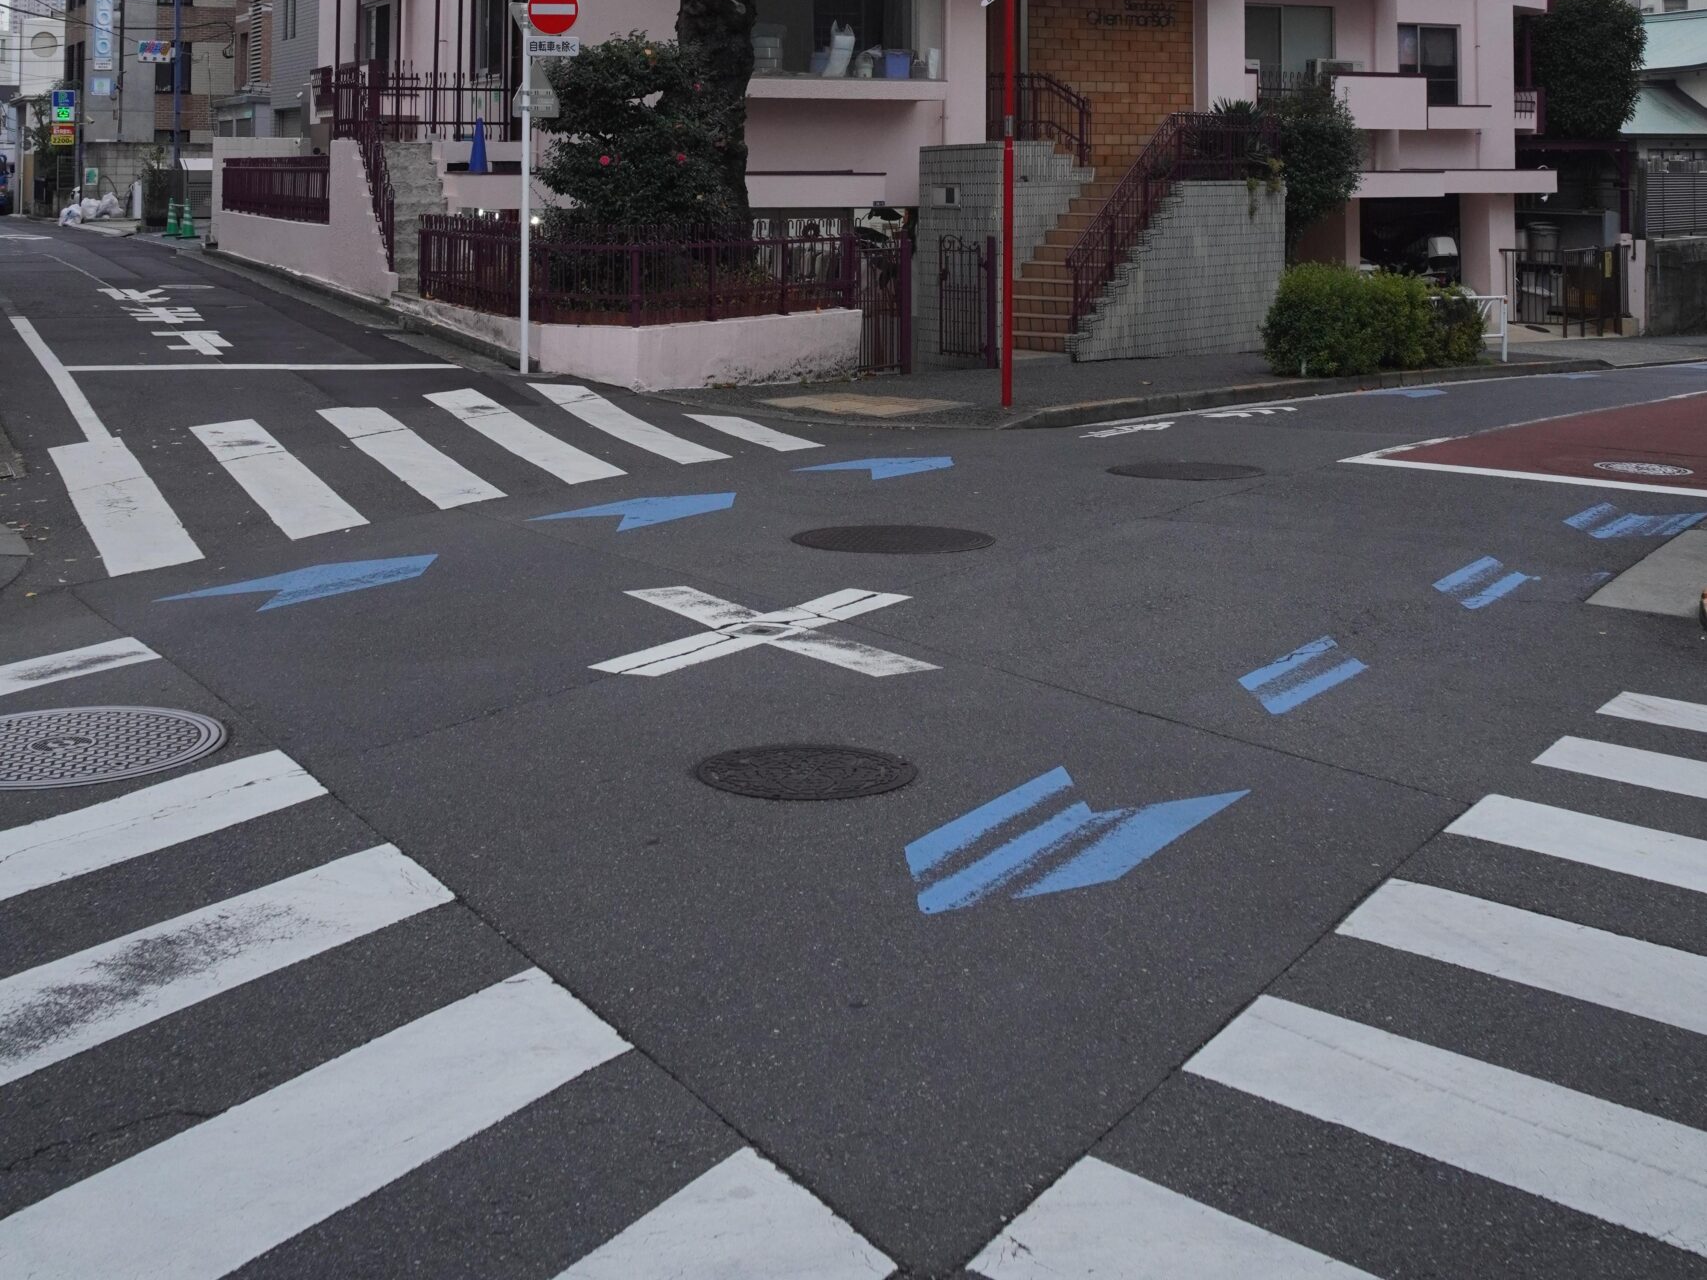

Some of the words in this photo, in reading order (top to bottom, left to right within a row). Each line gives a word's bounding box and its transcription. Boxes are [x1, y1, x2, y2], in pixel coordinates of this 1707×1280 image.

[529, 40, 576, 52] 自転車を除く
